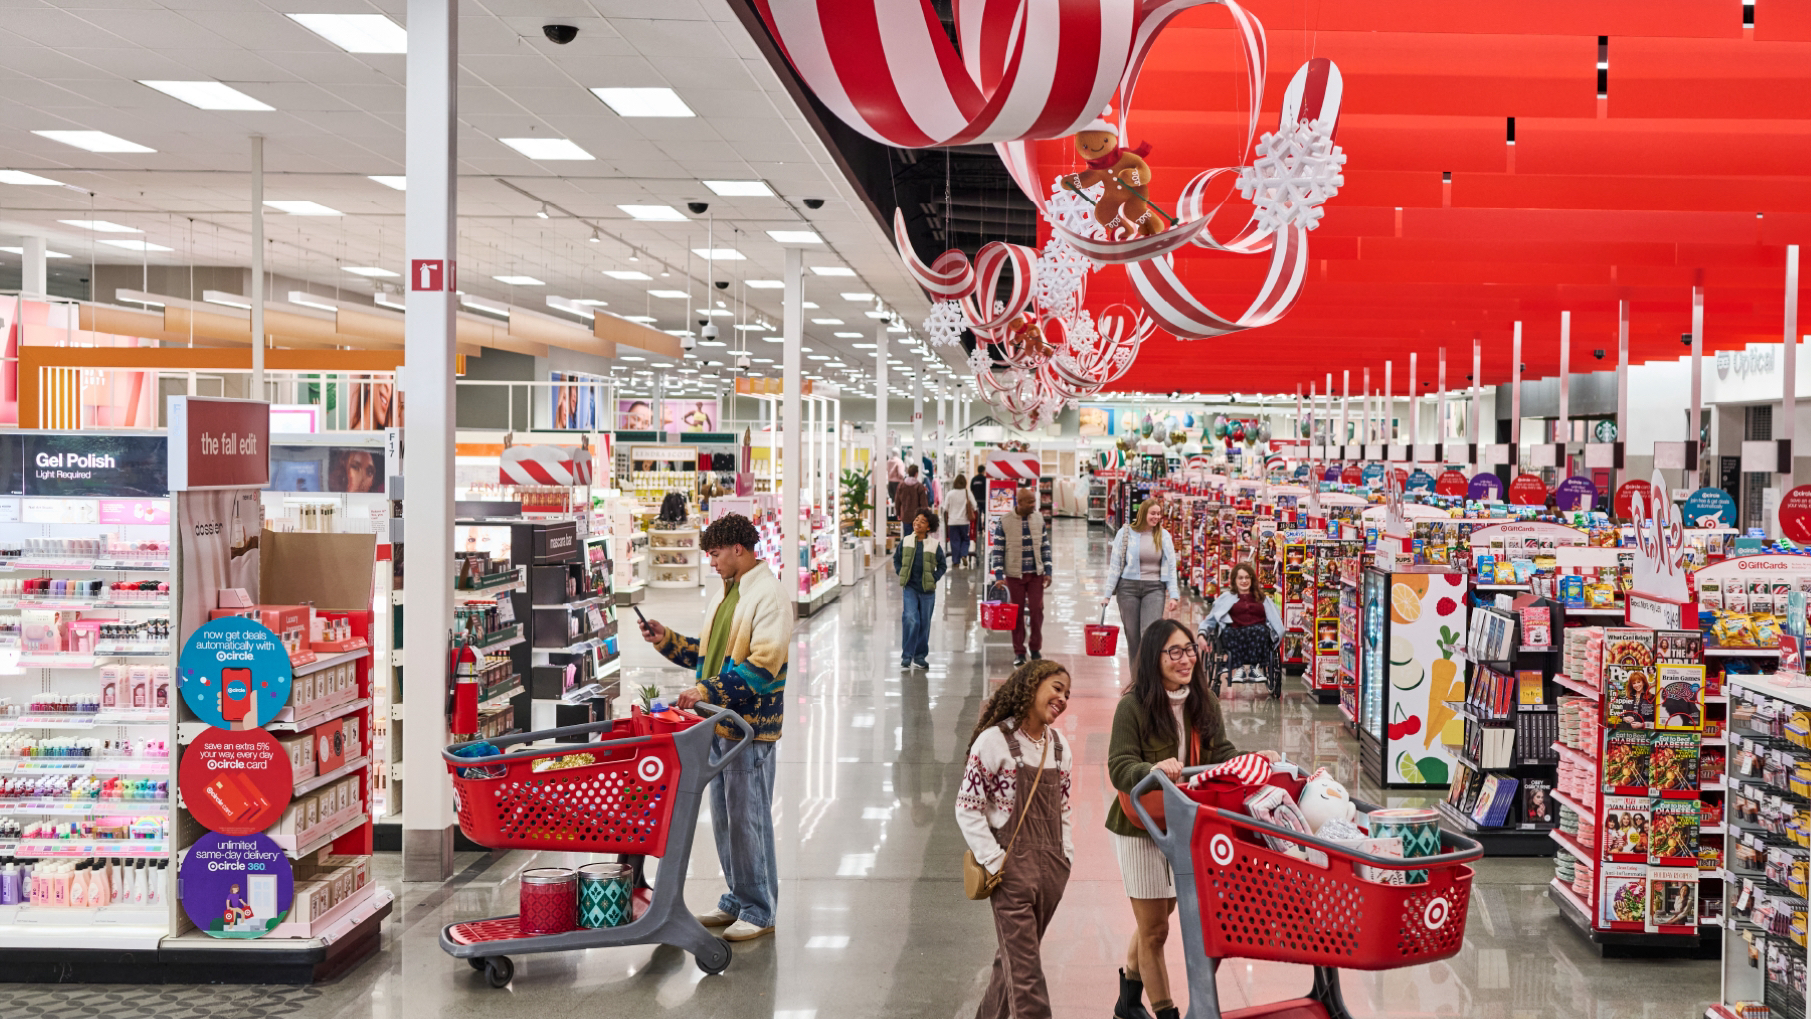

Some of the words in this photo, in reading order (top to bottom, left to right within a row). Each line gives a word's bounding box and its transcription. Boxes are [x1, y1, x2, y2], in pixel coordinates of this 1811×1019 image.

[1733, 343, 1775, 381] Optical
[201, 432, 219, 455] the
[221, 432, 237, 455] fall
[239, 433, 257, 455] edit
[35, 452, 63, 468] Gel
[67, 452, 116, 469] Polish
[35, 470, 55, 480] Light
[56, 470, 92, 480] Required
[195, 519, 223, 536] dossier
[550, 535, 567, 549] mascara
[1747, 561, 1788, 569] GiftCards
[204, 631, 223, 639] now
[225, 630, 240, 641] get
[242, 630, 267, 640] deals
[196, 640, 254, 652] automatically
[256, 641, 275, 650] with
[226, 651, 254, 660] circle
[1672, 649, 1686, 658] THE
[1611, 737, 1651, 745] DIABETES
[200, 751, 217, 760] your
[236, 752, 257, 760] every
[258, 750, 274, 760] day
[217, 759, 244, 769] circle
[246, 760, 267, 769] card
[217, 841, 257, 850] unlimited
[196, 850, 241, 860] same-day
[243, 850, 278, 862] delivery
[218, 861, 246, 871] circle
[247, 862, 265, 871] 360
